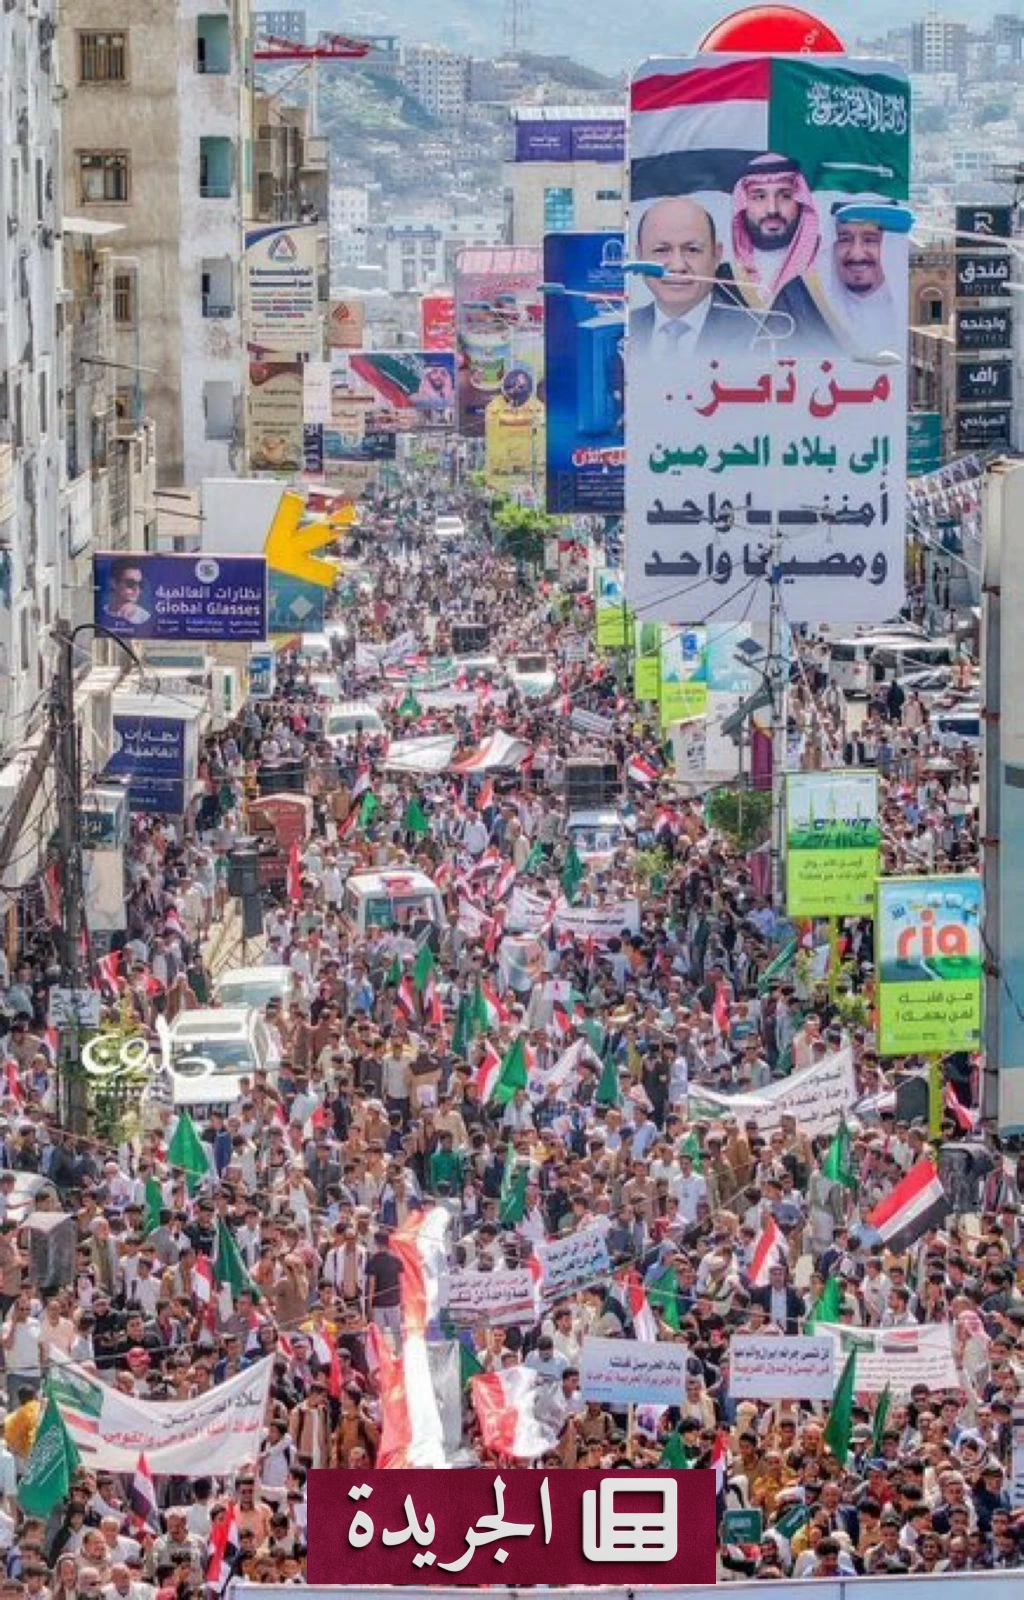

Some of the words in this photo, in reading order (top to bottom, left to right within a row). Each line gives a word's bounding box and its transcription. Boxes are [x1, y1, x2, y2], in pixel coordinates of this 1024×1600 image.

[960, 260, 1008, 284] فندق
[809, 360, 890, 418] من
[649, 434, 770, 475] الحرمين
[783, 435, 836, 473] بلاد
[849, 435, 889, 476] إلى
[647, 491, 732, 532] واحد
[645, 543, 731, 584] واحد
[155, 601, 203, 615] Global
[207, 602, 260, 616] Glasses
[897, 908, 969, 956] ria
